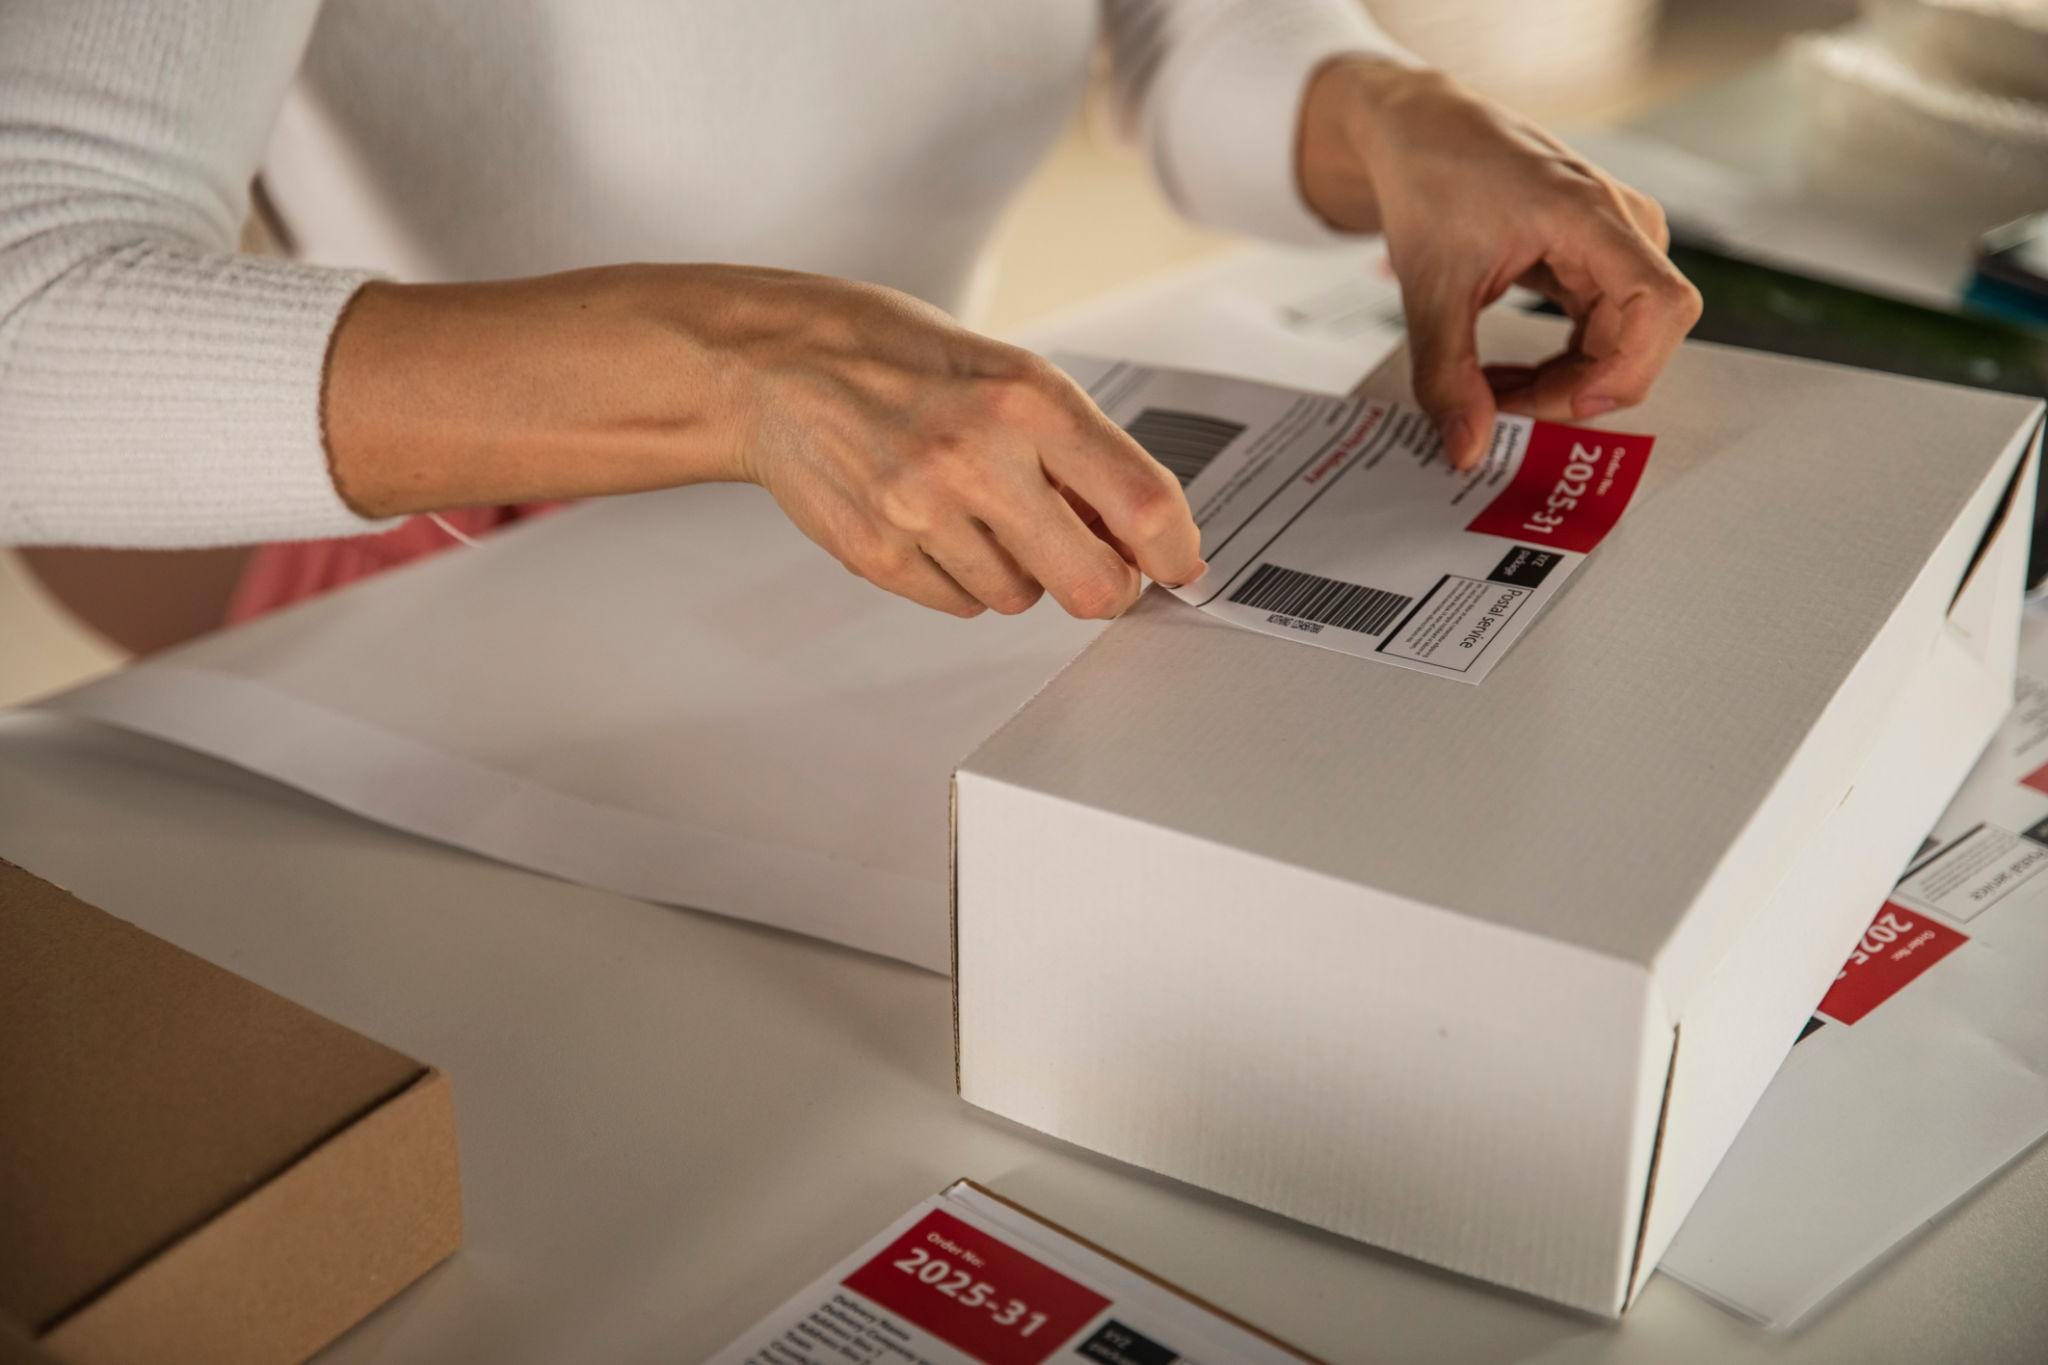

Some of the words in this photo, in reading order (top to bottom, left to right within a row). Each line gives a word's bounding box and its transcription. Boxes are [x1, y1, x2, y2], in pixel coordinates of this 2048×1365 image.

[1522, 442, 1603, 534] 2025-31
[1487, 588, 1523, 617] Postal
[1459, 617, 1495, 649] service
[926, 1232, 962, 1255] Order
[961, 1251, 985, 1269] No:
[893, 1247, 1048, 1337] 2025-31
